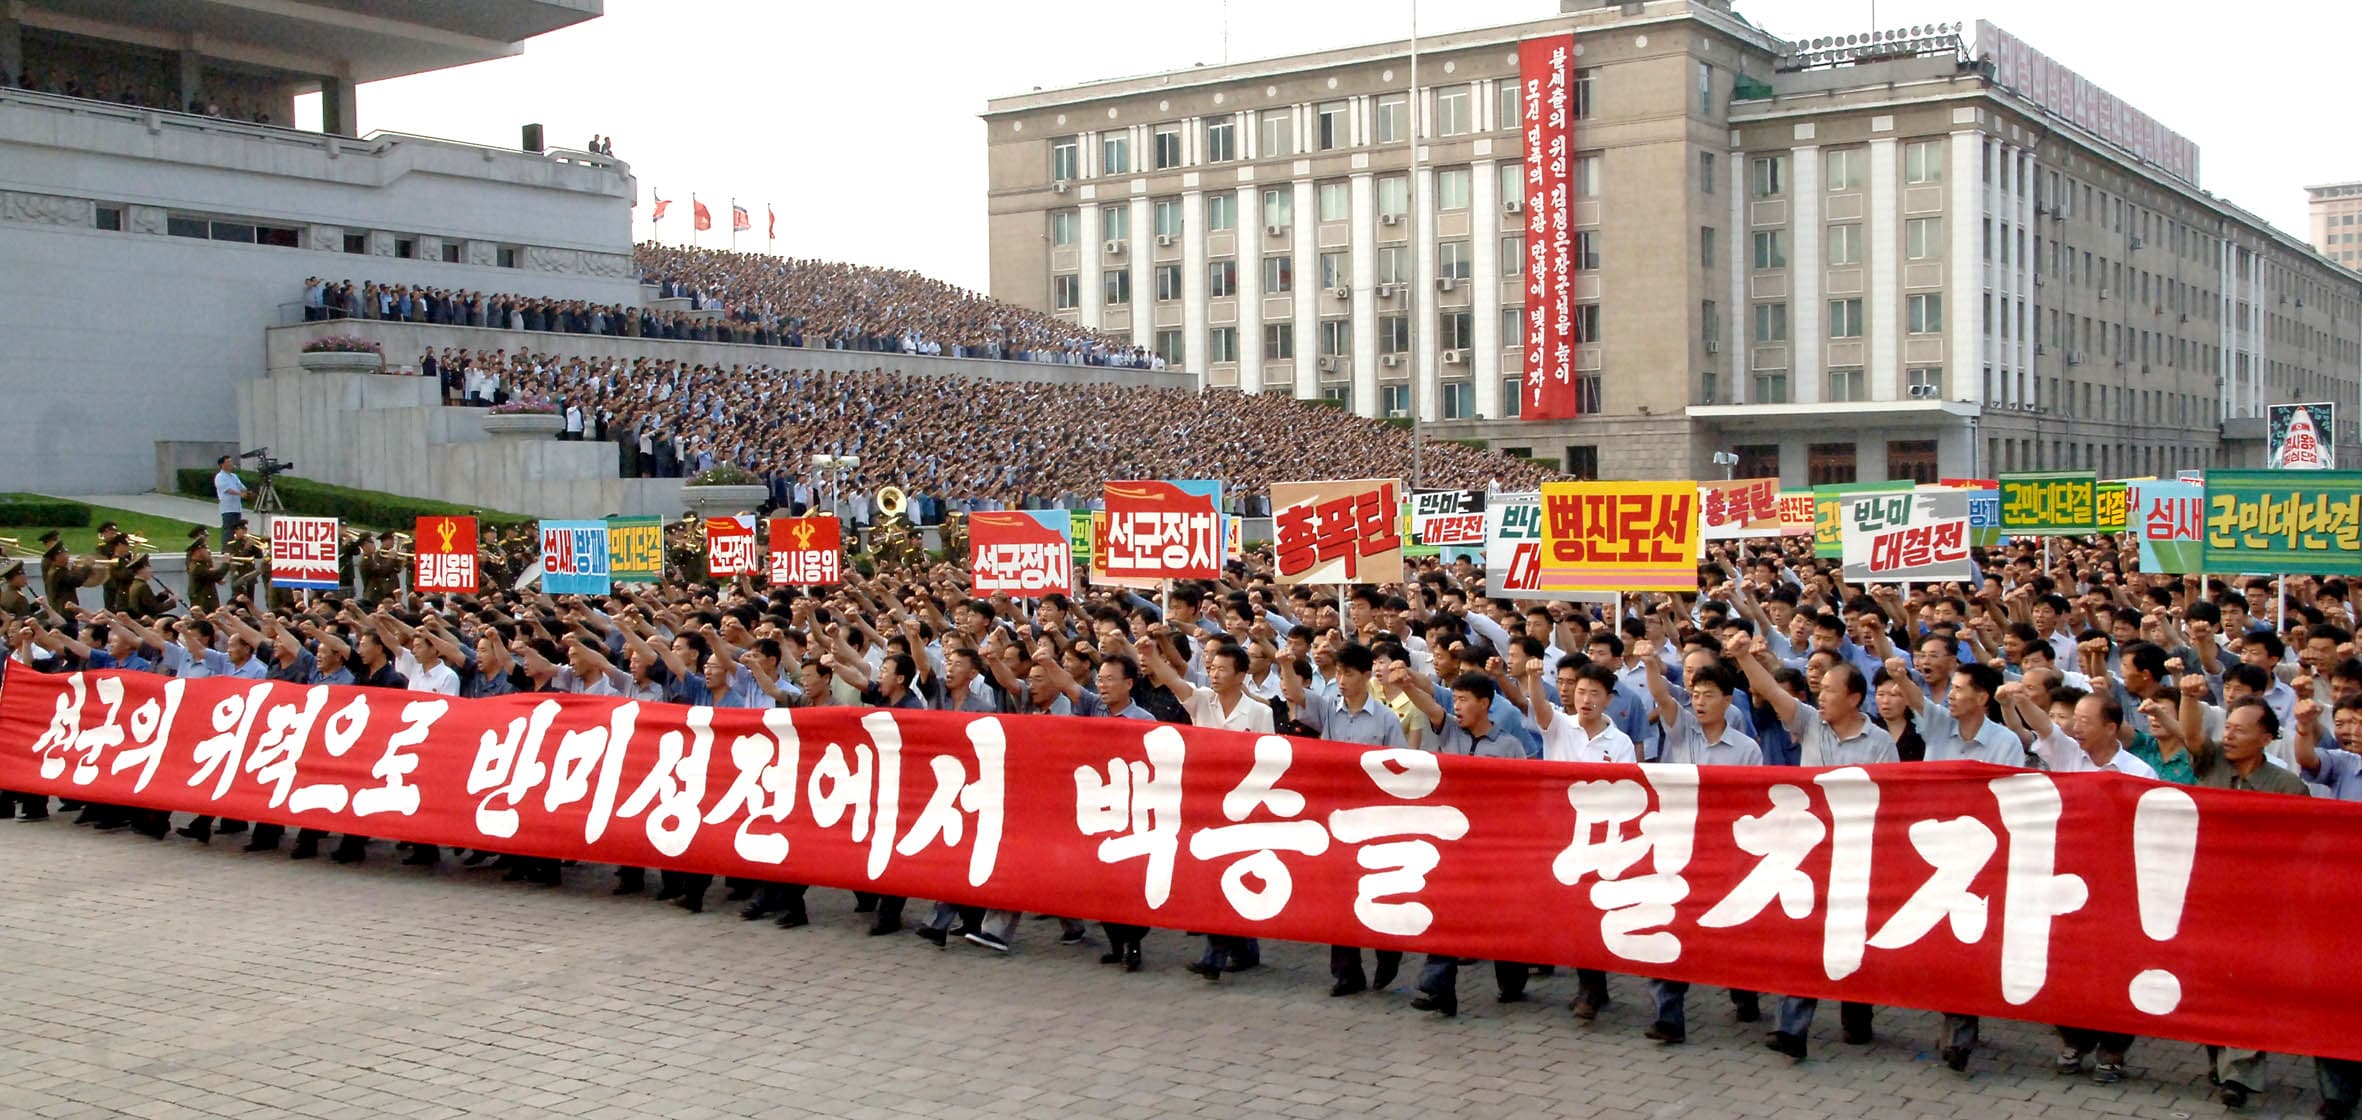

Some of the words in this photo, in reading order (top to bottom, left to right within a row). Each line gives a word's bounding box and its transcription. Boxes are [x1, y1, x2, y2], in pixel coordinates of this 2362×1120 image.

[1525, 79, 1541, 121] 모신
[1547, 46, 1567, 129] 불세출의
[1527, 124, 1543, 186] 민족의
[1548, 135, 1566, 178] 위인
[1530, 191, 1547, 233] 영광
[1530, 239, 1547, 299] 만방에
[1550, 183, 1571, 336] 김정은장군님을
[1528, 305, 1545, 407] 빛내이자!
[1554, 341, 1570, 384] 높이
[1418, 491, 1460, 516] 반미
[1705, 480, 1777, 529] 총폭탄
[1853, 494, 1912, 532] 반미
[2004, 481, 2093, 525] 군민대단결
[2207, 492, 2362, 550] 군민대단결
[273, 519, 336, 561] 일심단결
[1108, 511, 1218, 570] 선군정치
[1276, 482, 1401, 580] 총폭탄
[1422, 515, 1484, 545] 대결전
[1547, 493, 1691, 562] 병진로선
[1868, 520, 1969, 573] 대결전
[418, 553, 475, 588] 결사옹위
[708, 534, 757, 574] 선군정치
[771, 549, 839, 583] 결사옹위
[974, 543, 1069, 590] 선군정치
[32, 671, 186, 793] 선군의
[187, 682, 449, 817] 위력으로
[467, 699, 1007, 887] 반미성전에서
[1073, 725, 1471, 937] 백승을
